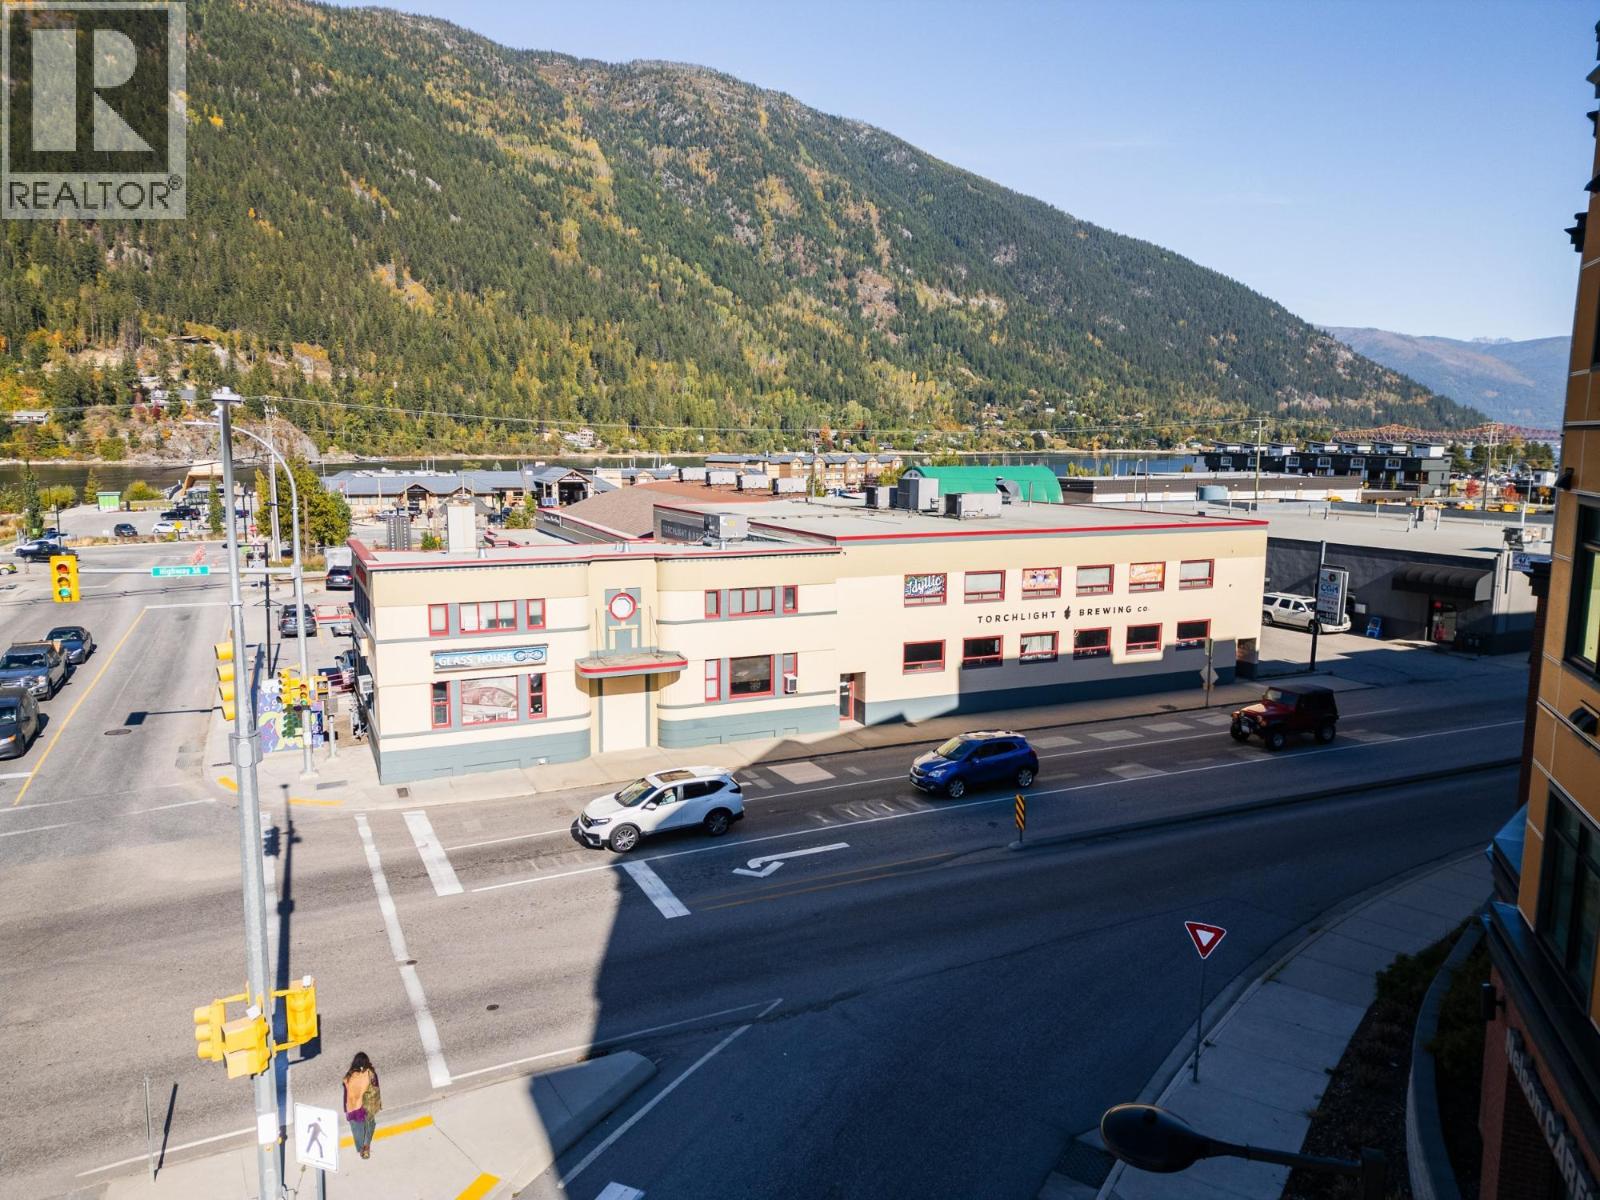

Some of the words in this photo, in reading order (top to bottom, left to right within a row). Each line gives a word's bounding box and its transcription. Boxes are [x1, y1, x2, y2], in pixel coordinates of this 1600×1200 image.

[160, 567, 190, 577] Highway
[977, 611, 1056, 624] TORCHLIGHT
[1079, 605, 1133, 617] BREWING
[438, 656, 473, 666] GLASS
[478, 653, 512, 664] HOUSE
[1545, 1110, 1595, 1200] CARE
